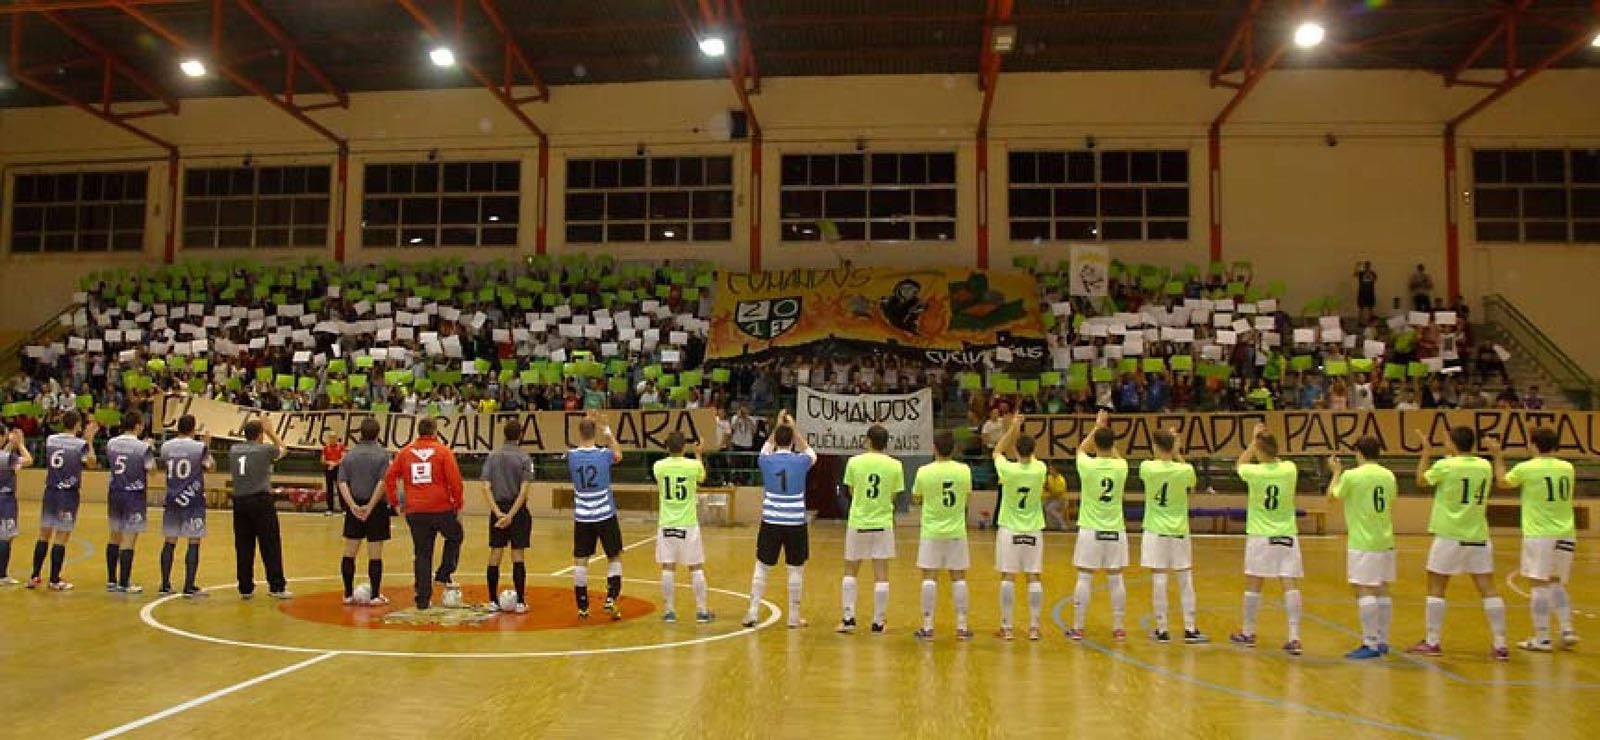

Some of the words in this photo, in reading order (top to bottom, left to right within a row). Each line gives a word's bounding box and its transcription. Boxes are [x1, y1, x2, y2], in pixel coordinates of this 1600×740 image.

[807, 395, 920, 422] COMANDOS
[433, 412, 545, 451] SANTA
[564, 410, 701, 449] CARA
[1284, 411, 1388, 452] PARA
[50, 449, 65, 469] 6
[114, 454, 128, 475] 5
[166, 458, 192, 480] 10
[238, 455, 247, 476] 1
[576, 464, 599, 489] 12
[664, 476, 688, 501] 15
[775, 469, 788, 492] 1
[866, 473, 881, 499] 3
[1544, 476, 1569, 501] 10
[942, 481, 956, 508] 5
[1017, 487, 1031, 509] 7
[1099, 477, 1114, 503] 2
[1154, 482, 1168, 506] 4
[1264, 484, 1279, 511] 8
[1373, 485, 1386, 513] 6
[1461, 478, 1486, 505] 14
